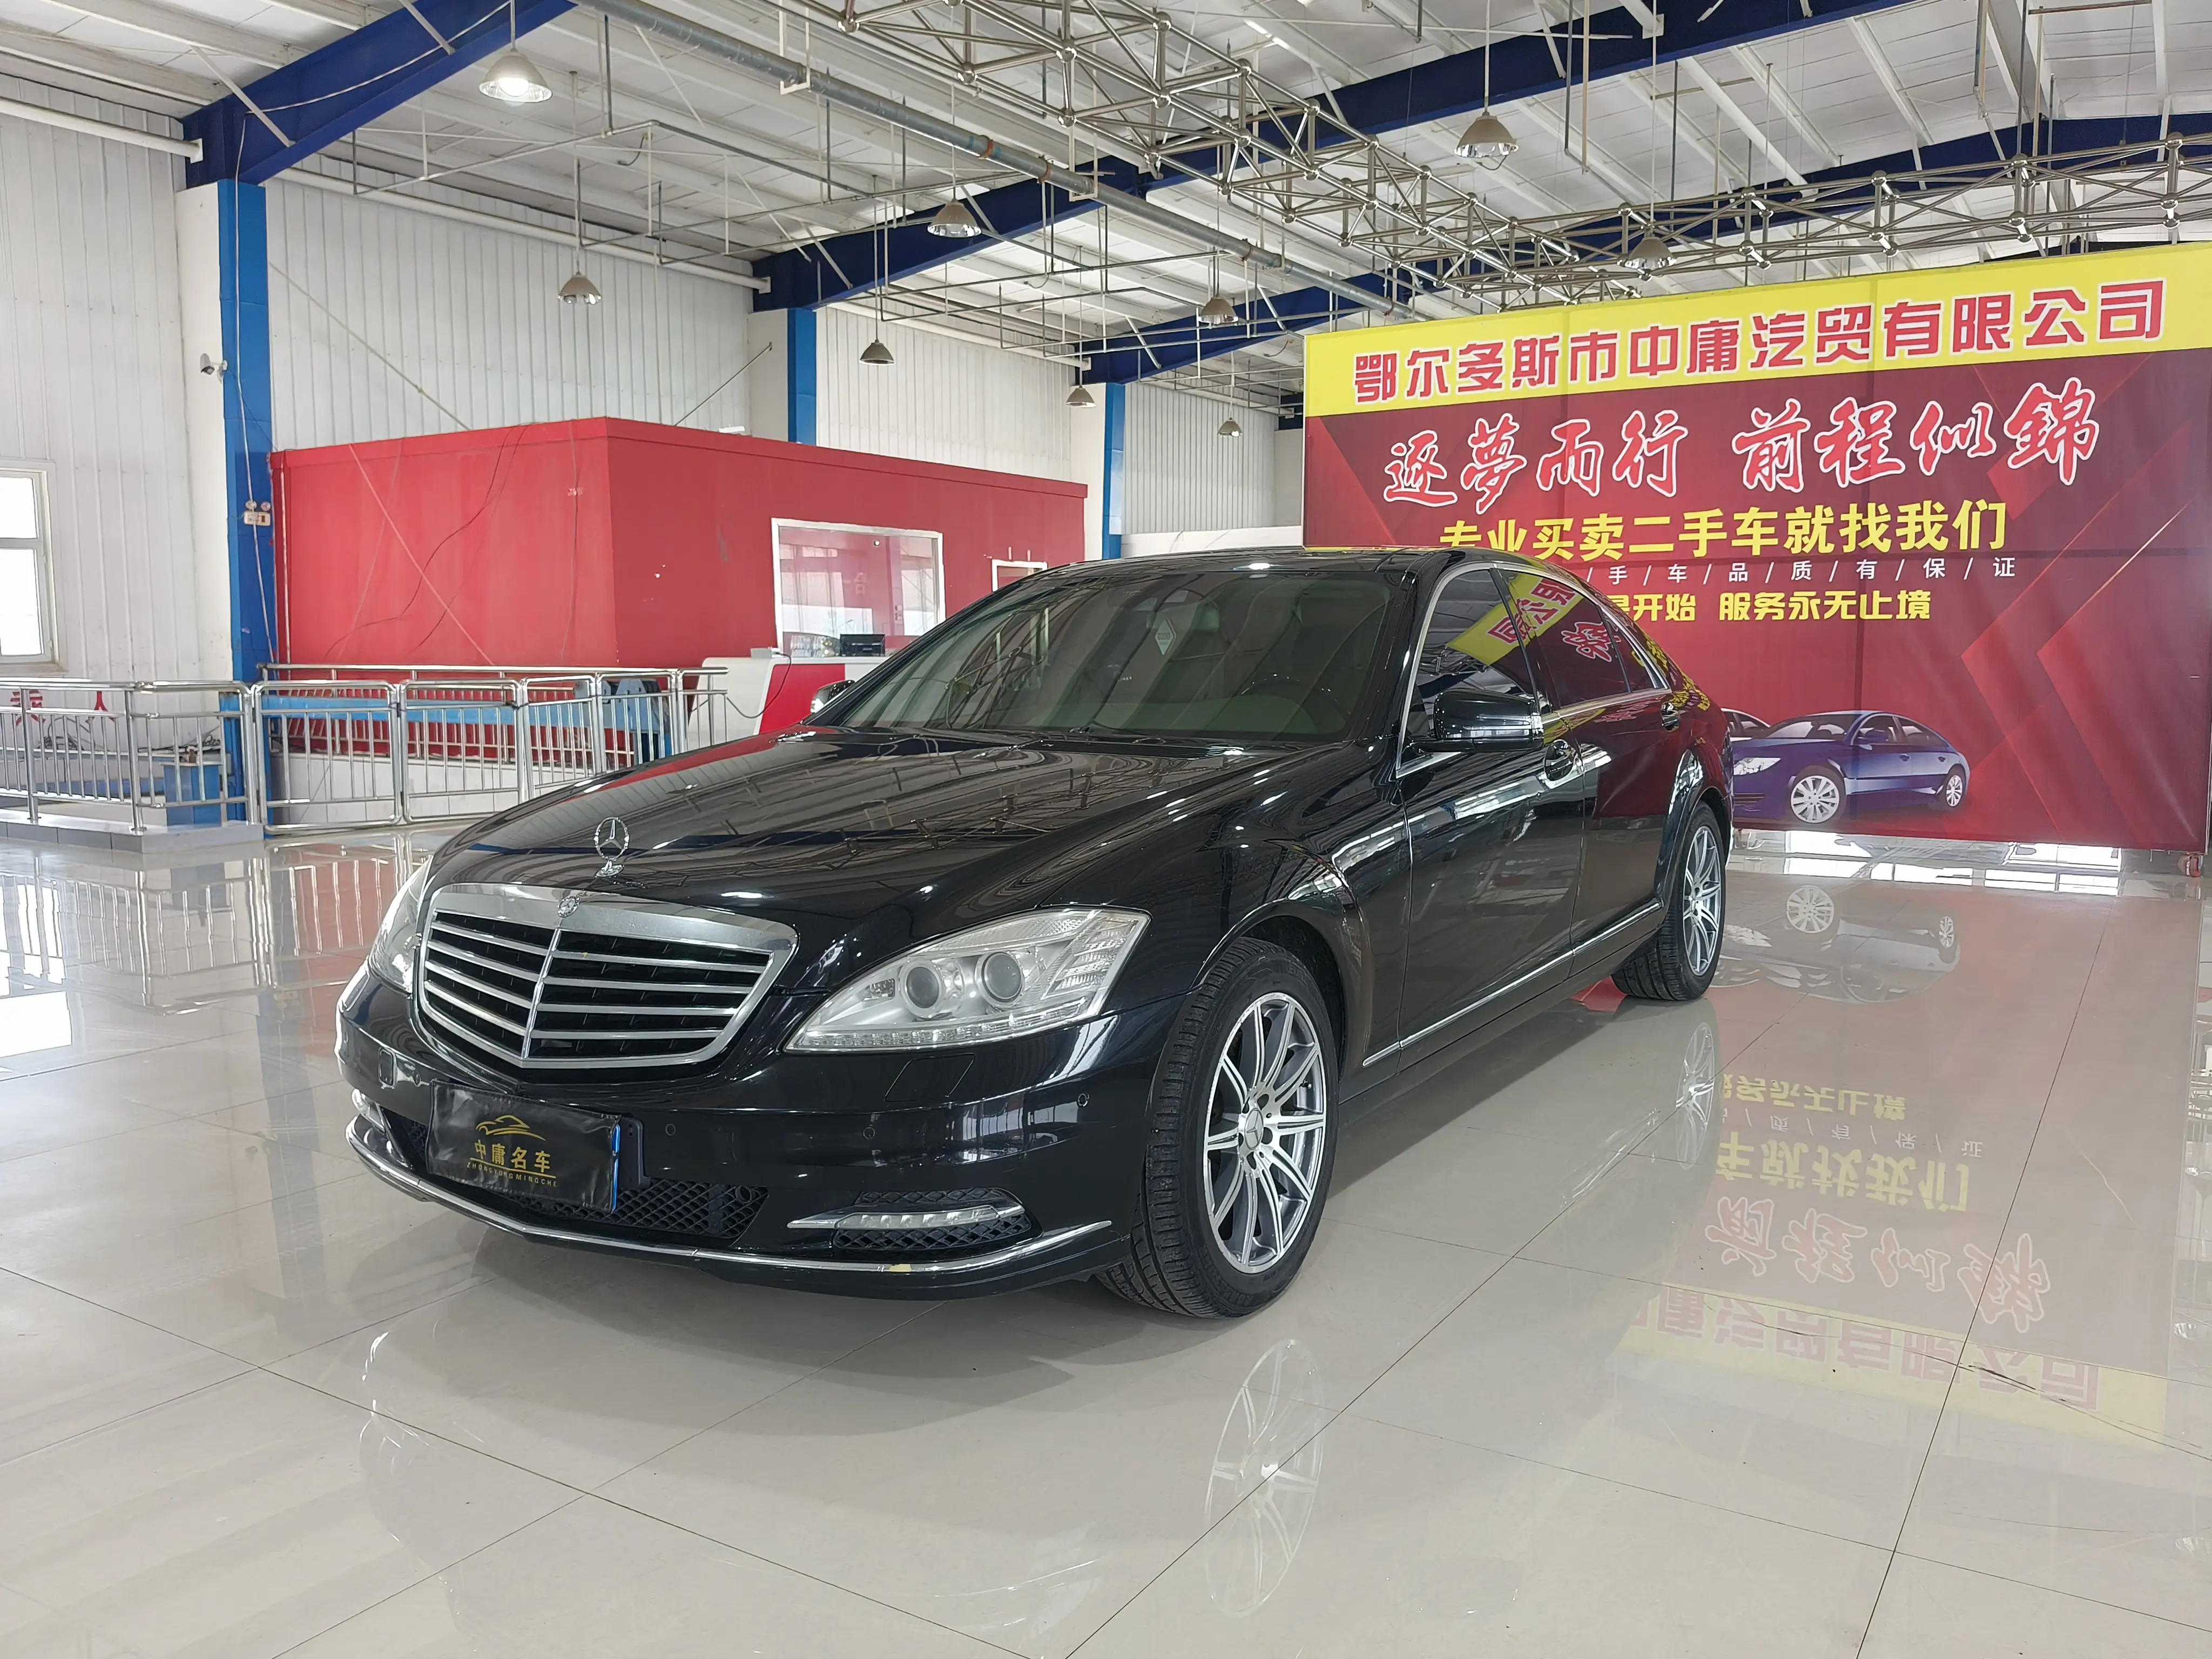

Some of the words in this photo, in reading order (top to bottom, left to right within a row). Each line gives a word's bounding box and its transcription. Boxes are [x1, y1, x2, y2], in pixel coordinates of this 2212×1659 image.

[1354, 279, 2166, 404] 鄂尔多斯市中庸汽贸有限公司
[1440, 500, 2006, 561] 专业买卖二手车就找我们
[1719, 589, 1931, 622] 服务永无止境
[474, 1139, 550, 1172] 中庸名车
